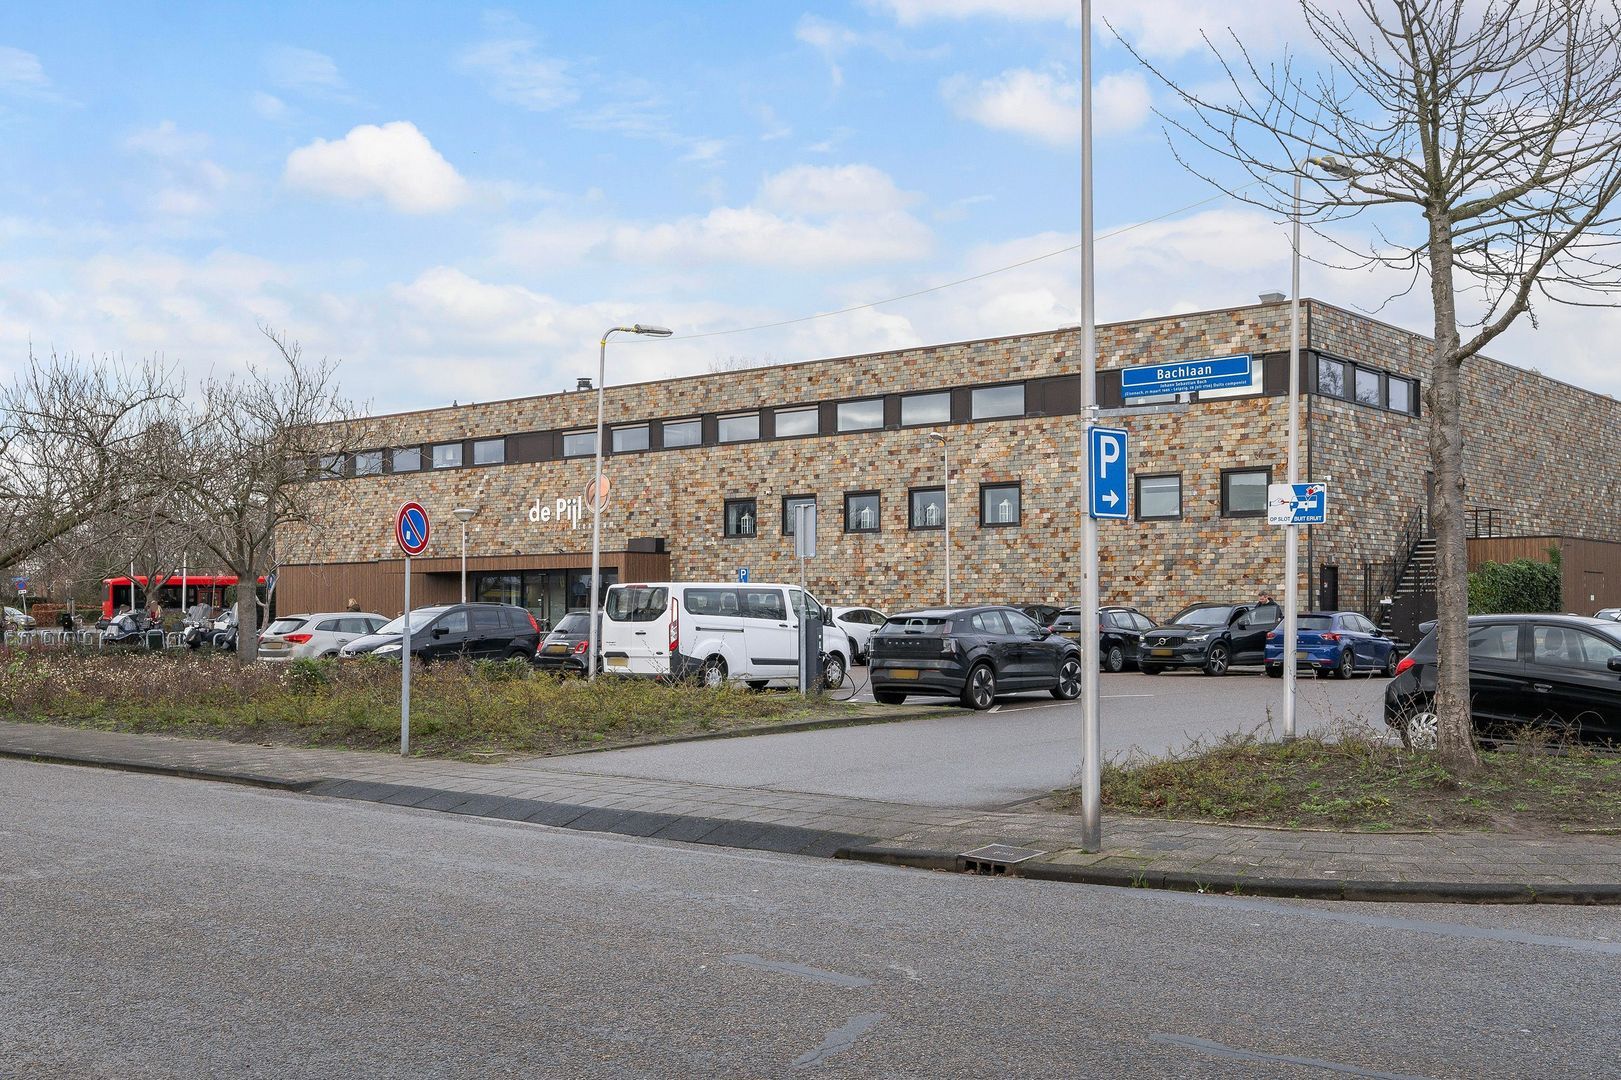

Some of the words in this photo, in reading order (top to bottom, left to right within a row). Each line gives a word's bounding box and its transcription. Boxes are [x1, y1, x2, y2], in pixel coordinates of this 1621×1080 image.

[1157, 366, 1211, 380] Bachlaan
[1100, 435, 1120, 479] P
[529, 499, 551, 522] de
[556, 496, 581, 530] Pijl
[740, 569, 747, 579] P
